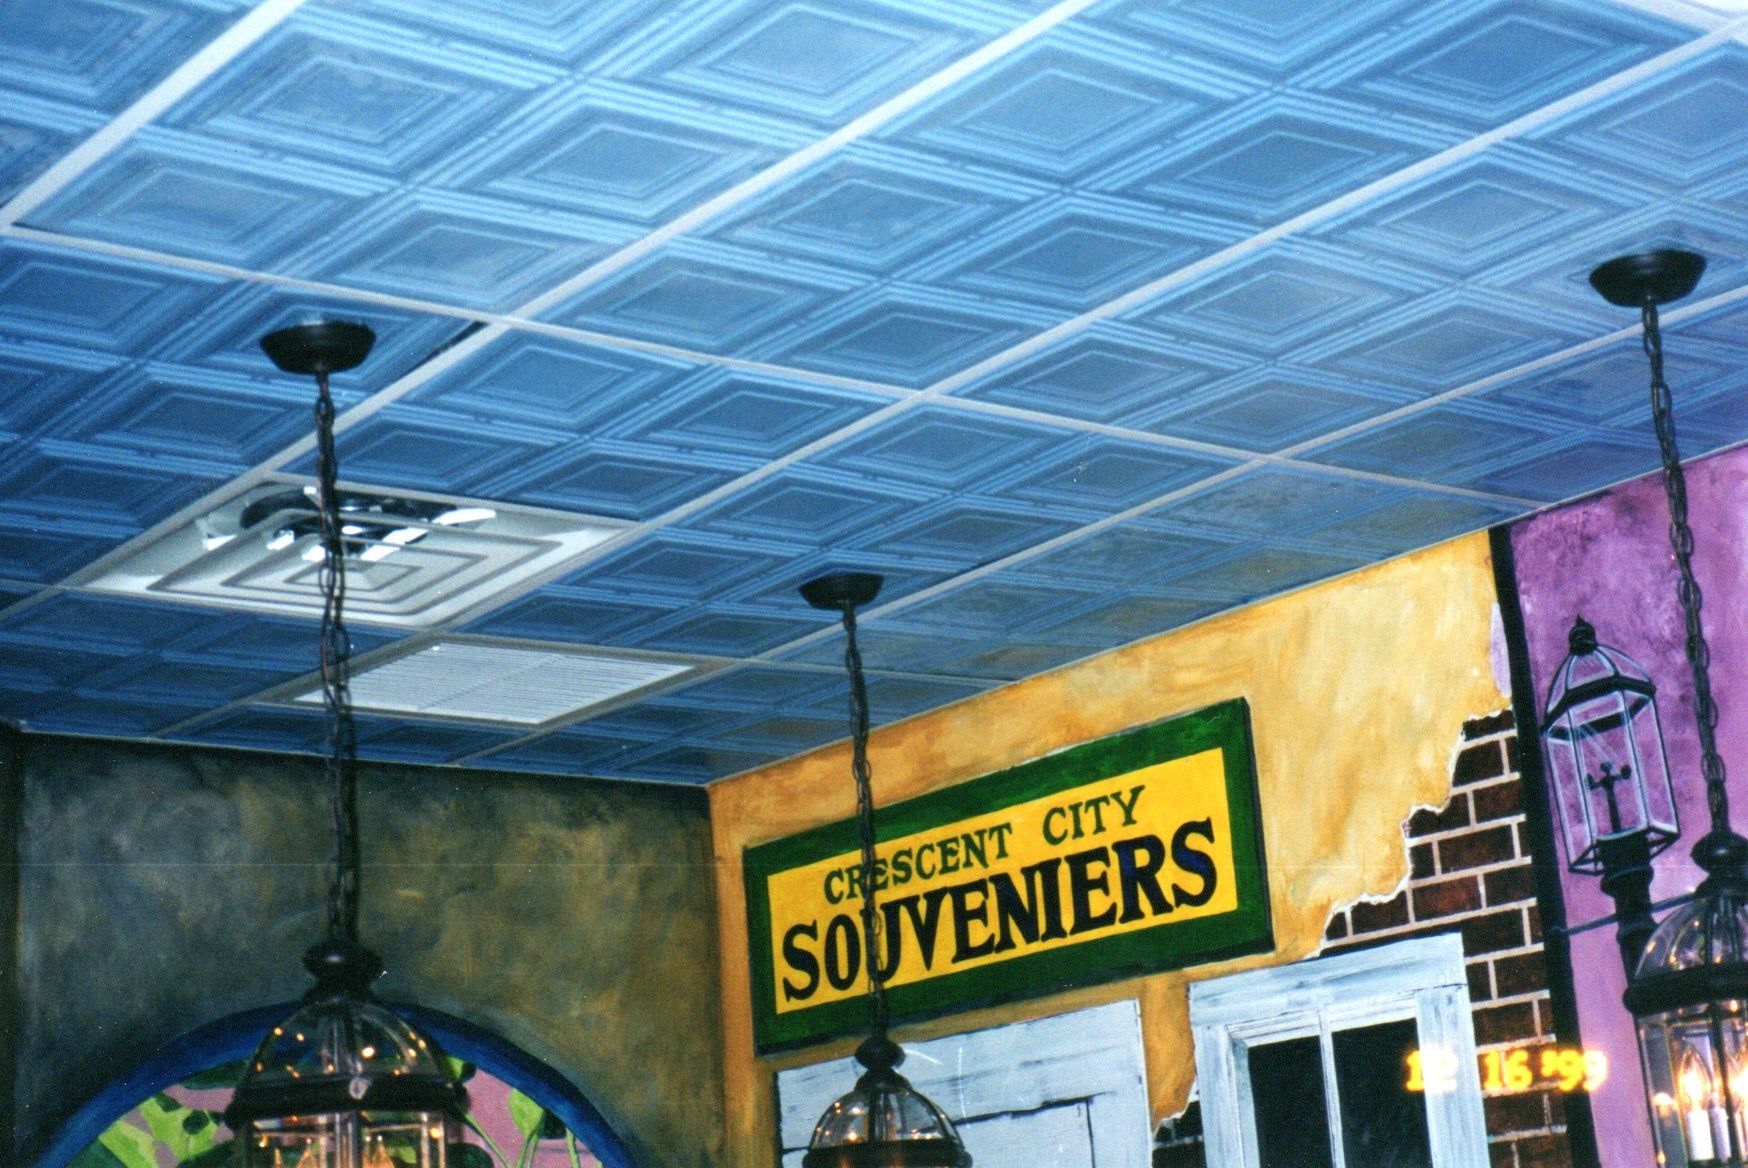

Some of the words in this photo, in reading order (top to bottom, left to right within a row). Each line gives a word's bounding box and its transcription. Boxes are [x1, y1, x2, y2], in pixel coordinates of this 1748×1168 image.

[782, 816, 1217, 1002] SOUVENIERS
[824, 822, 1012, 905] CRESCENT
[1042, 784, 1146, 845] CITY
